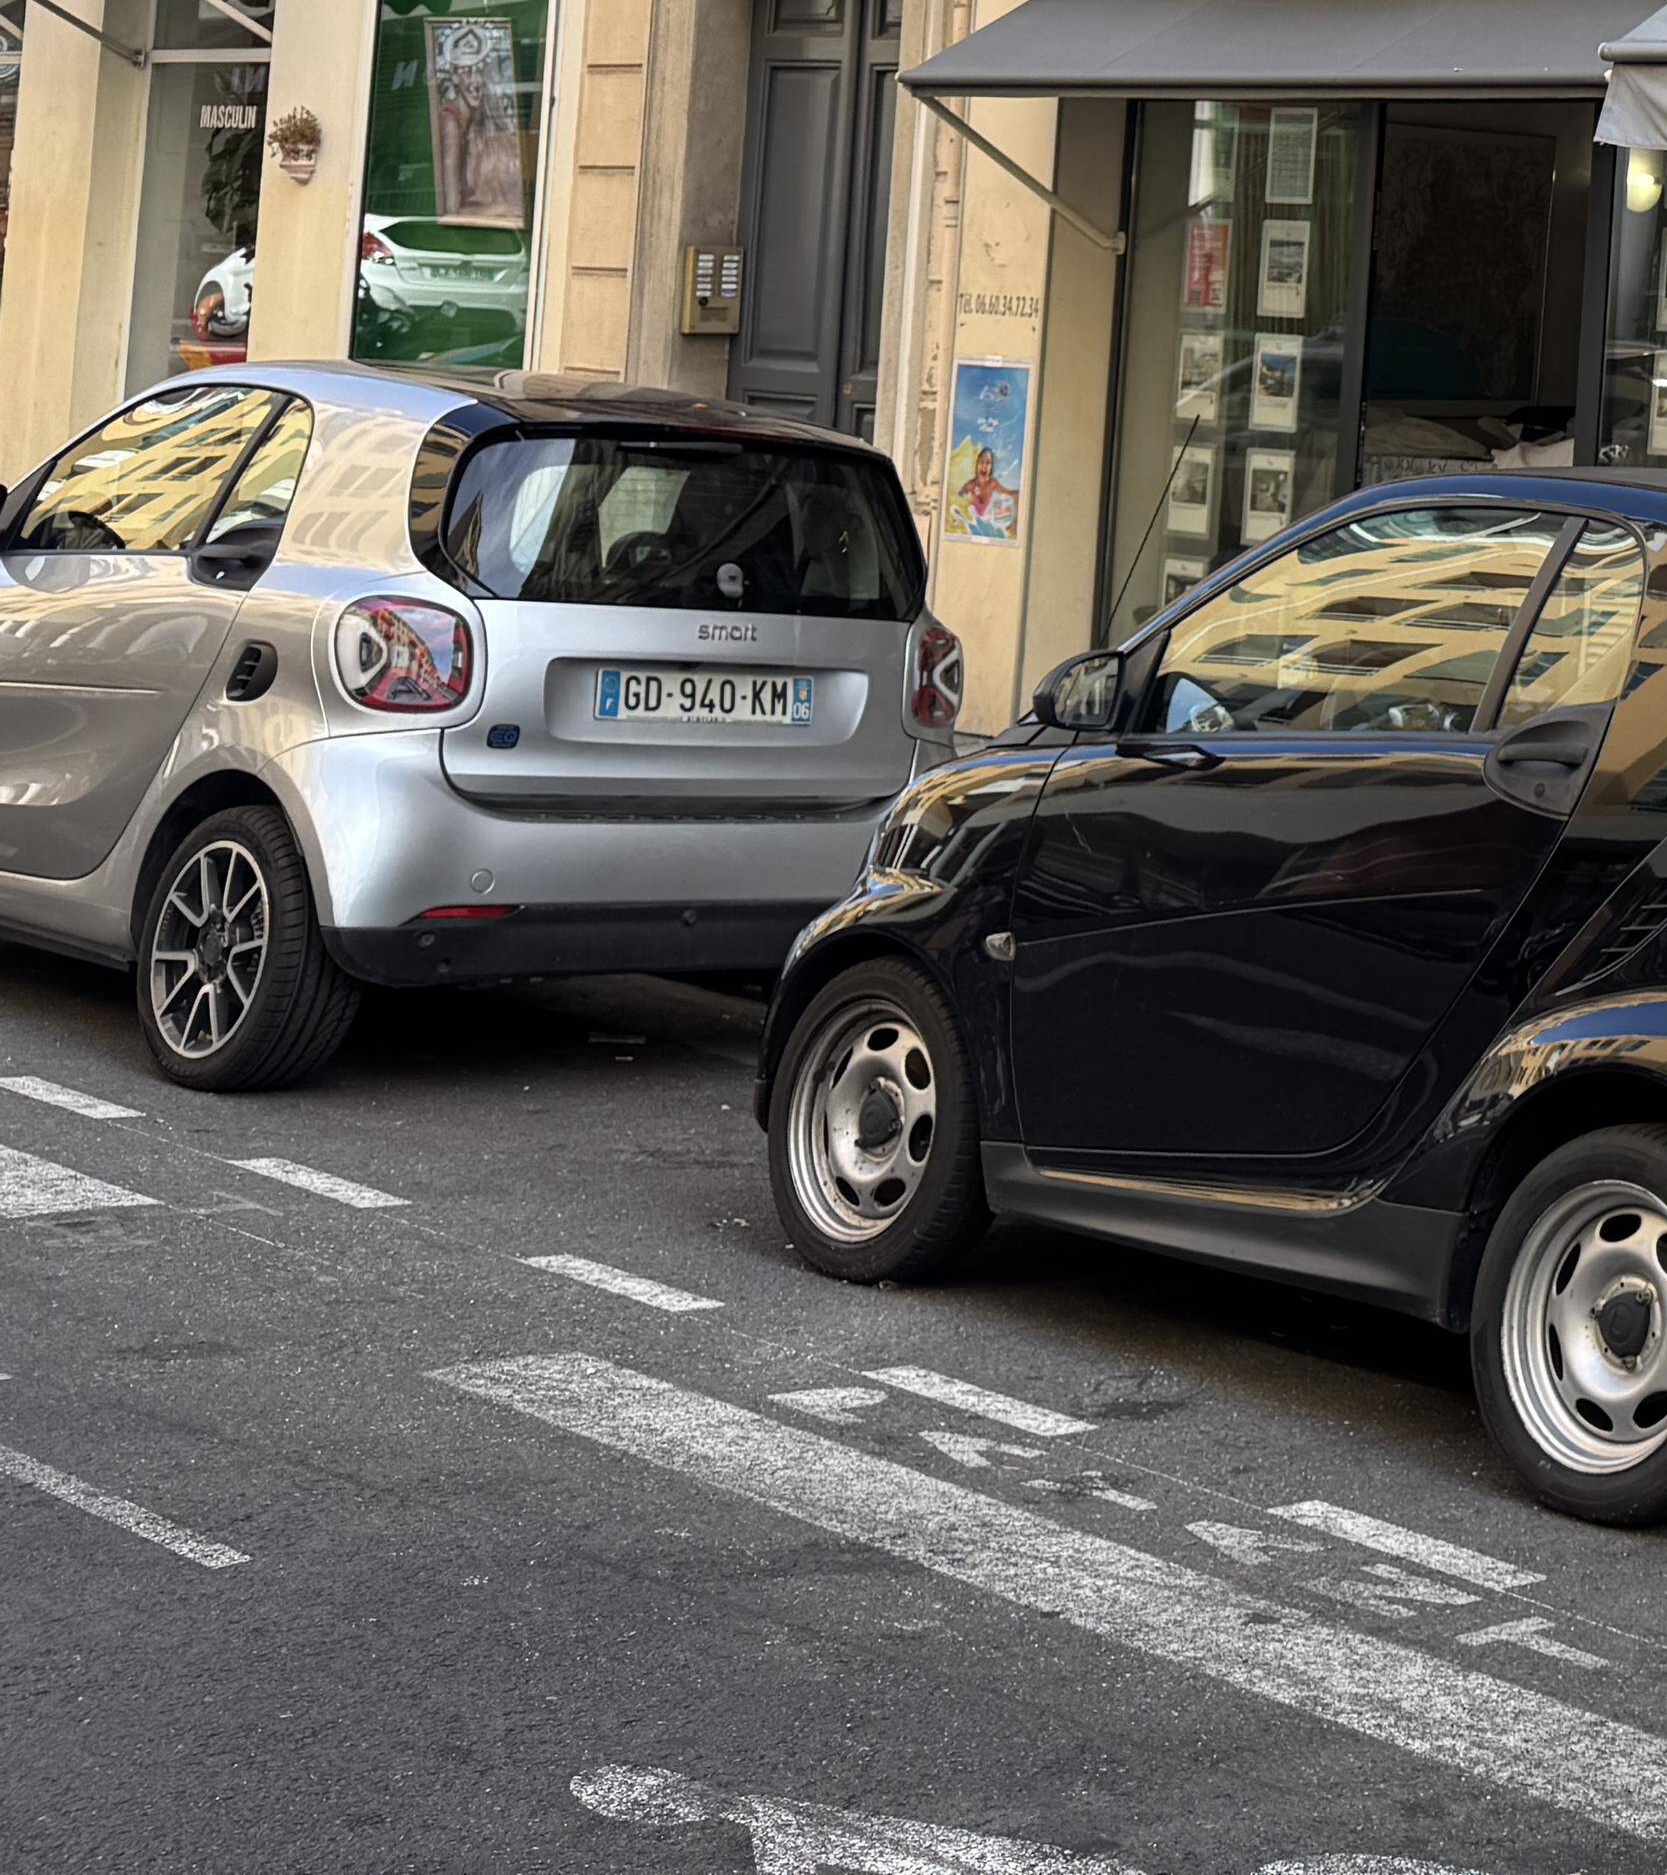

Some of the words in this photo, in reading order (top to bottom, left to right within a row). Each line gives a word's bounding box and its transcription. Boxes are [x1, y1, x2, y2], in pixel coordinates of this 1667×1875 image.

[200, 105, 257, 129] MASCULIN
[697, 624, 758, 643] smart
[624, 675, 790, 718] GD-940-KM
[792, 702, 811, 720] 06
